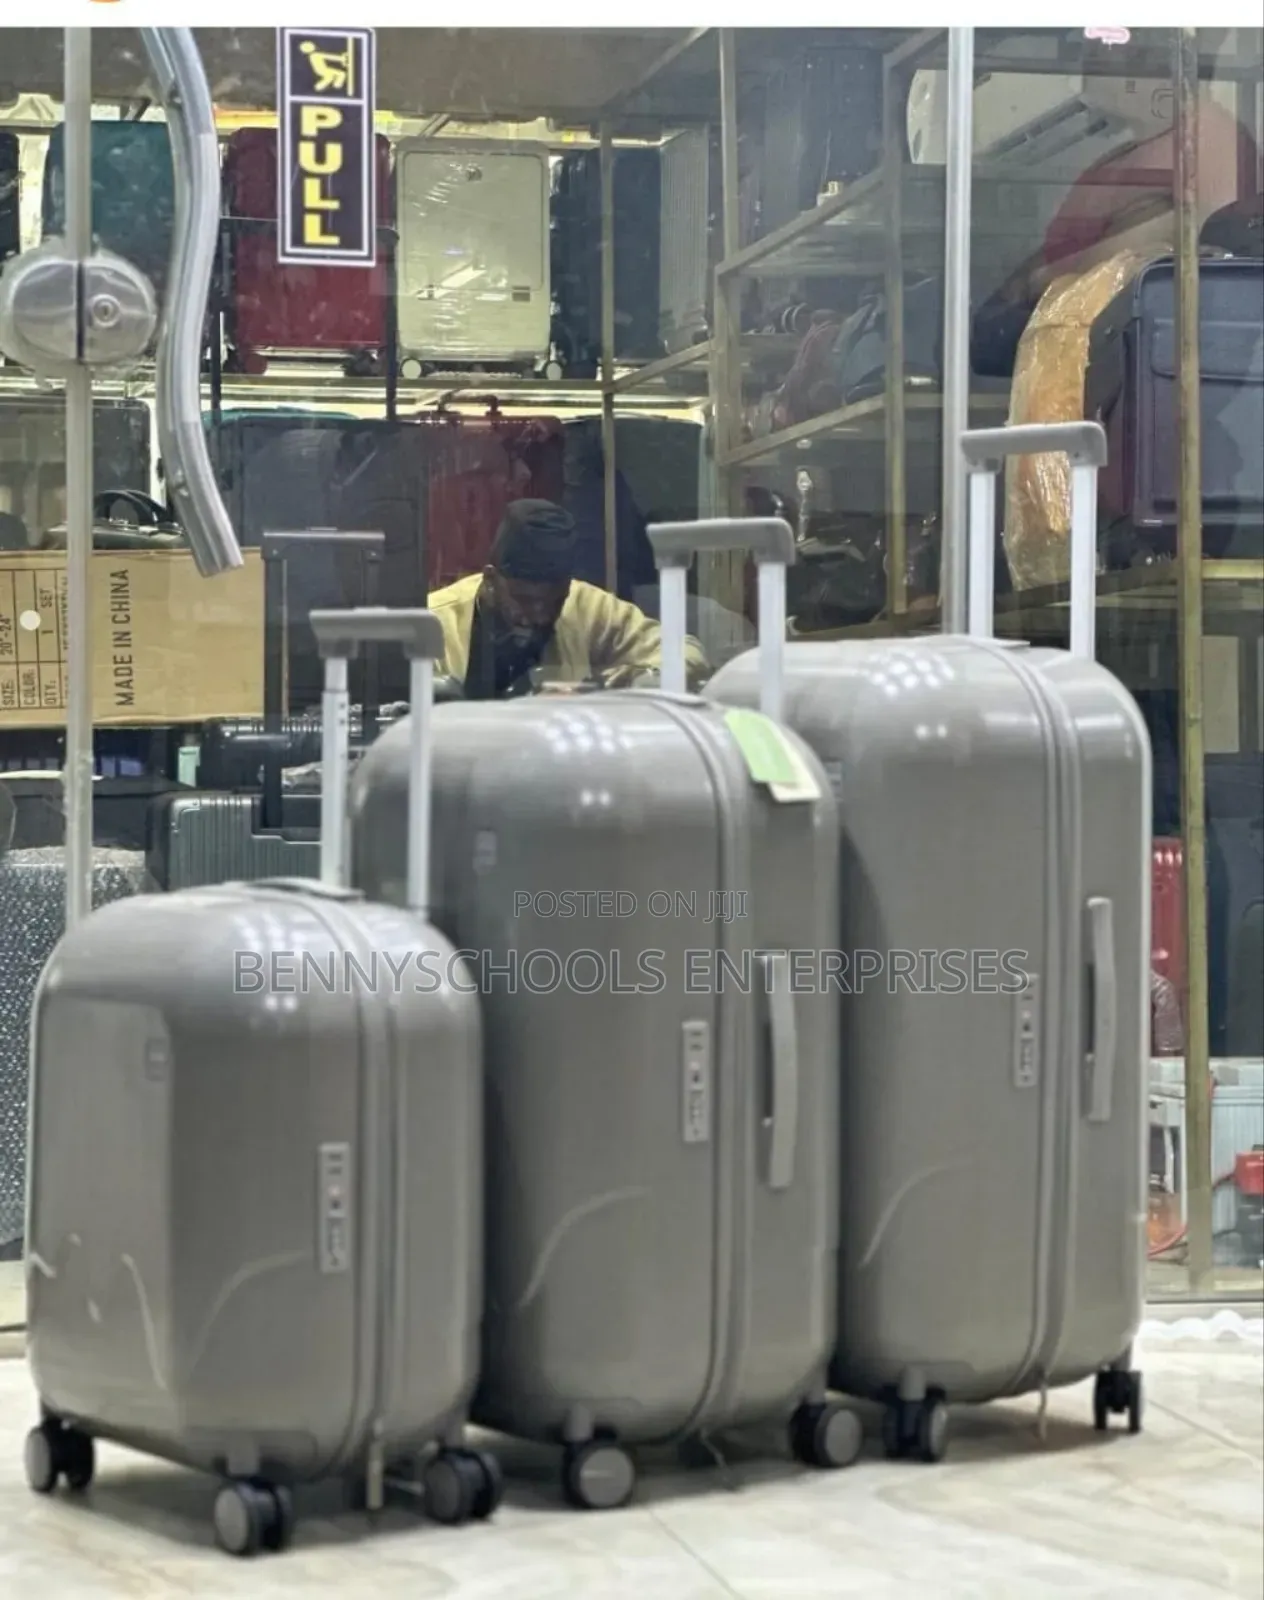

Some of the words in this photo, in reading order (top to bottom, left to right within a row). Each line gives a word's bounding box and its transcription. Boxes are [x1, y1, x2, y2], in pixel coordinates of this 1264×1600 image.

[299, 105, 343, 245] PULL
[39, 588, 52, 608] SET
[110, 569, 131, 625] CHINA
[113, 631, 132, 648] IN
[44, 680, 57, 705] QTY:
[113, 654, 135, 706] MADE
